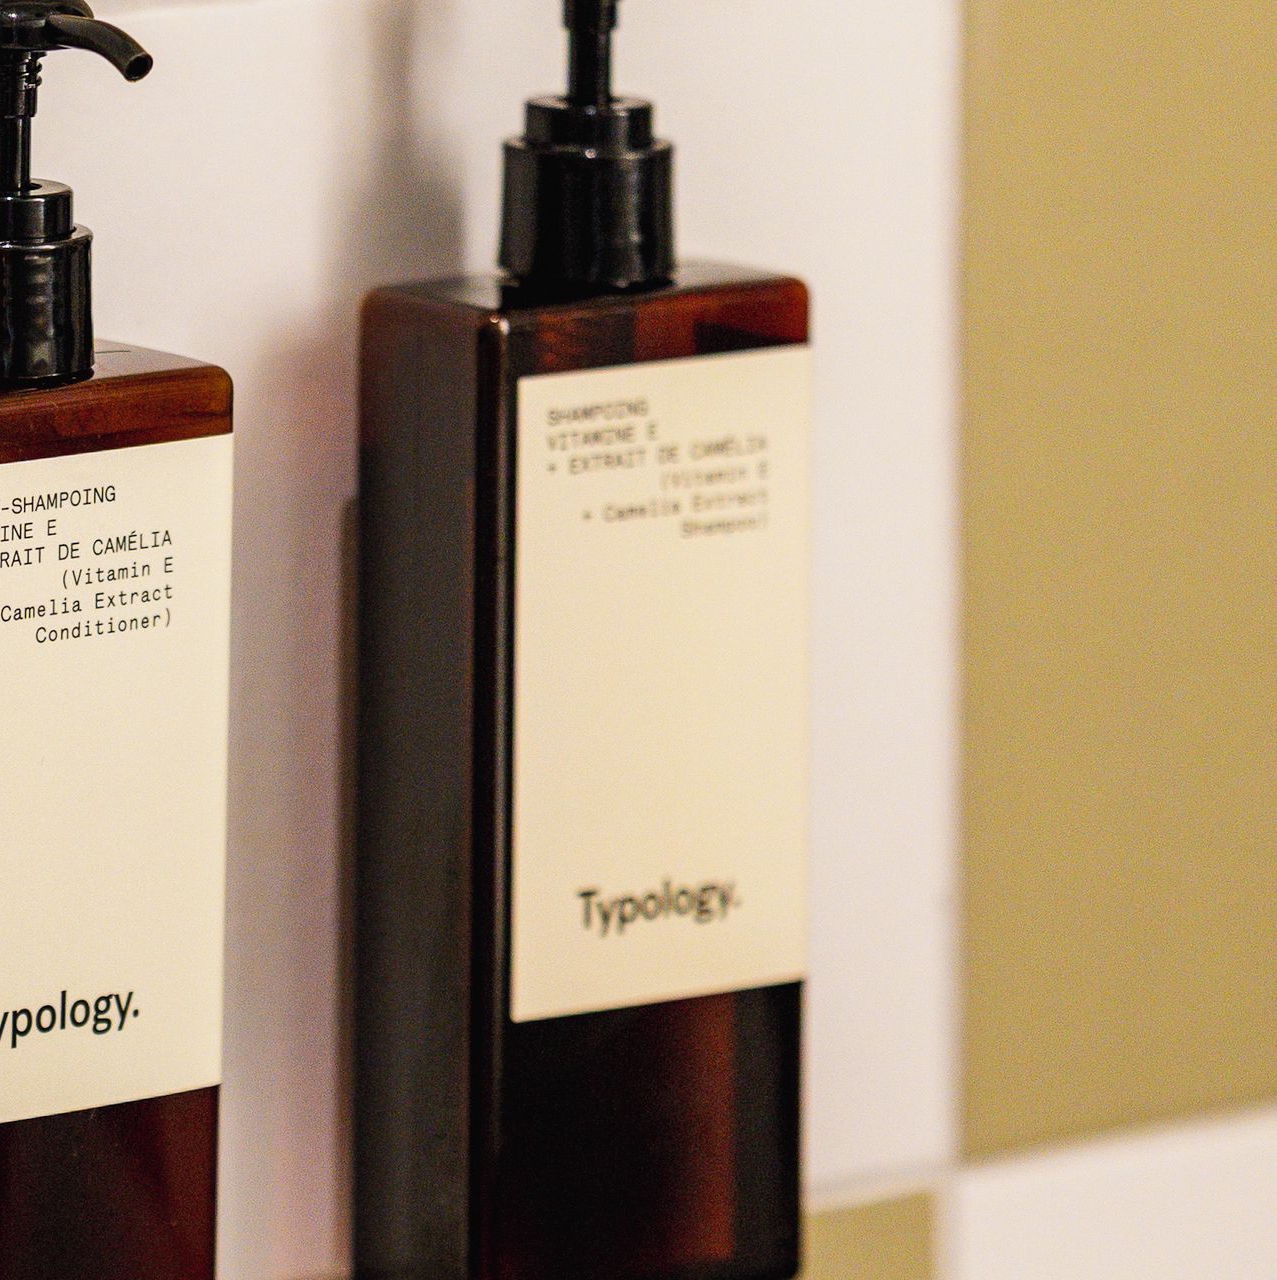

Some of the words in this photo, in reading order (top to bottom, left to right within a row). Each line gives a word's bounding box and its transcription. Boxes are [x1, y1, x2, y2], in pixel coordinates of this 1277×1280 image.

[47, 519, 57, 536] E
[58, 542, 80, 561] DE
[92, 529, 172, 556] CAMÉLIA
[62, 561, 150, 590] (Vitamin
[164, 556, 174, 573] E
[0, 599, 82, 623] Camelia
[95, 584, 173, 610] Extract
[35, 607, 172, 644] Conditioner)
